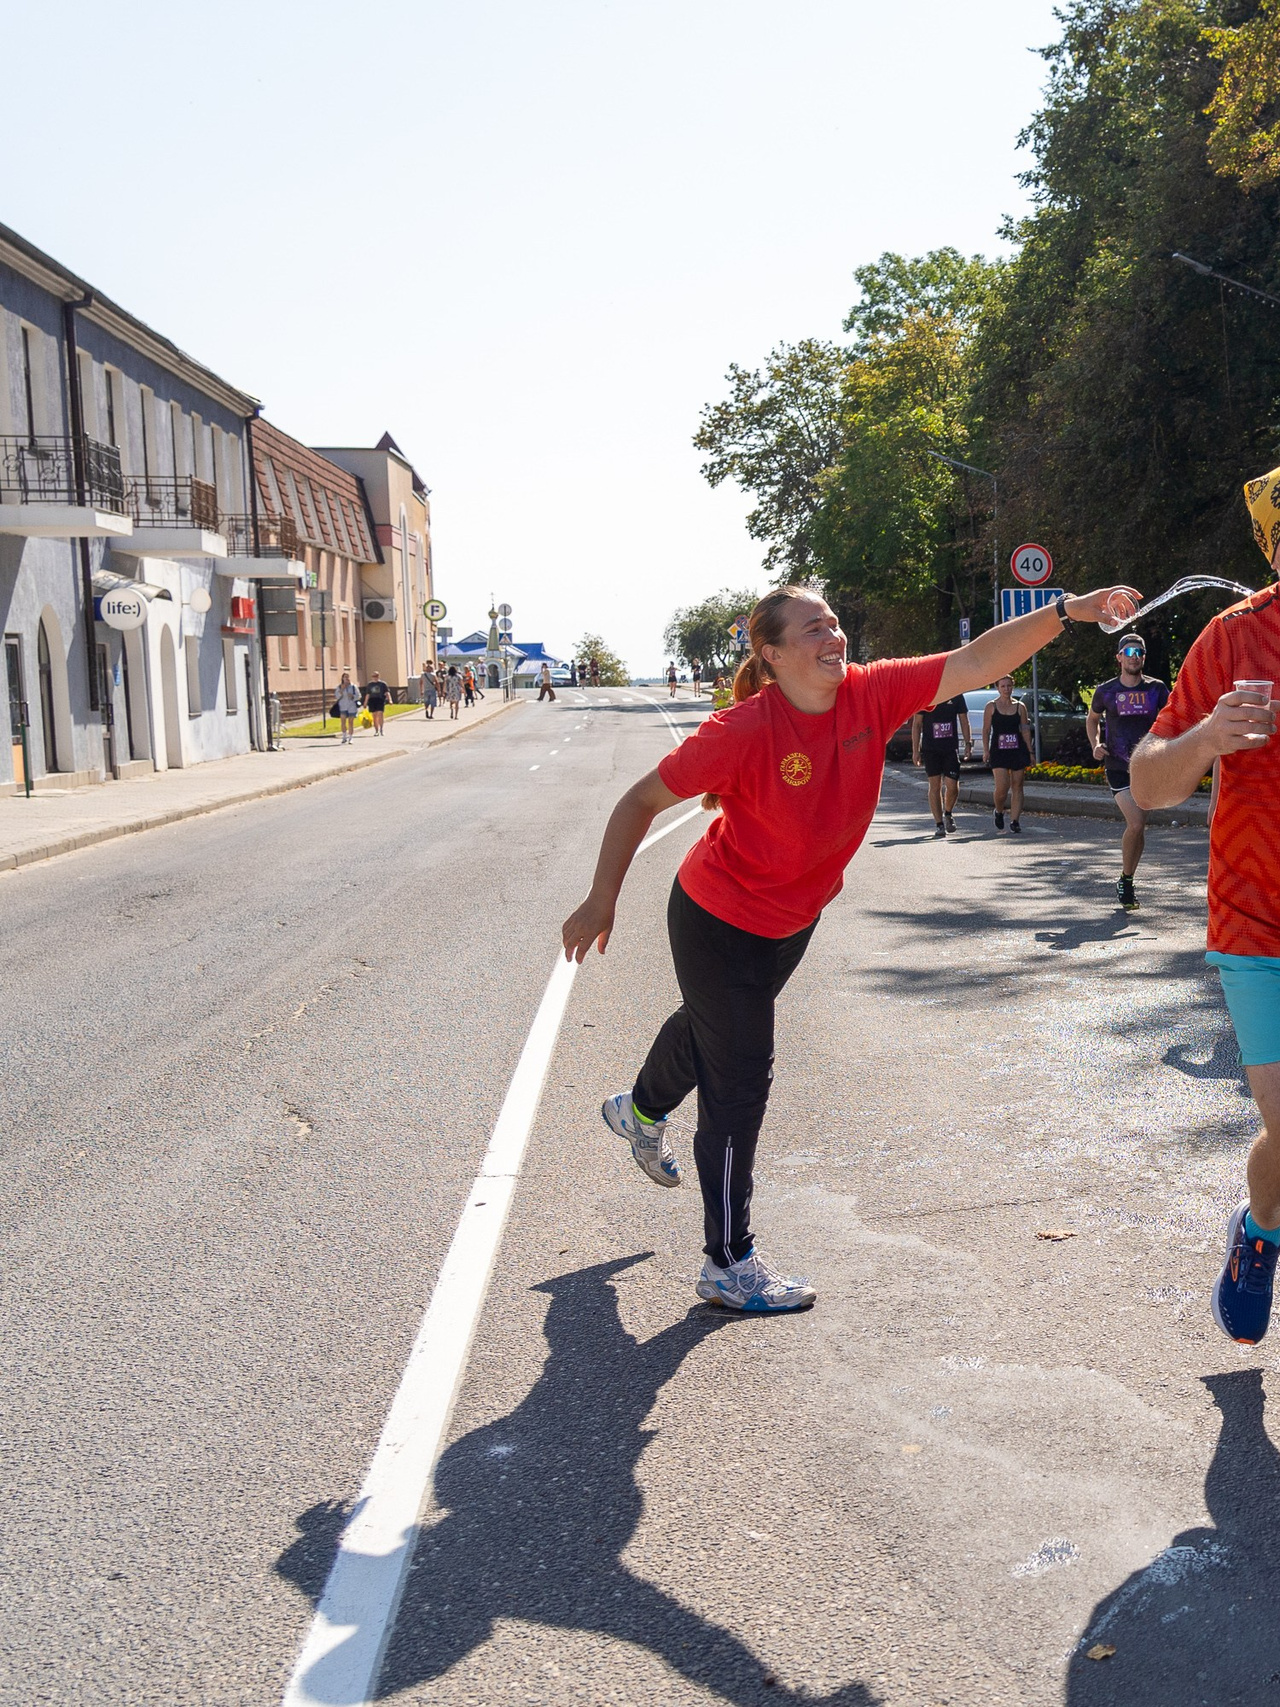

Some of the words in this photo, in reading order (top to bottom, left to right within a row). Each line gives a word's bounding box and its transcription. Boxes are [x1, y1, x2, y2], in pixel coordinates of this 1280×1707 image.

[1020, 557, 1043, 572] 40
[107, 601, 141, 617] life:)
[430, 605, 440, 616] F
[961, 620, 968, 637] P
[1129, 692, 1145, 704] 211
[941, 722, 951, 731] 327
[1005, 734, 1016, 743] 326
